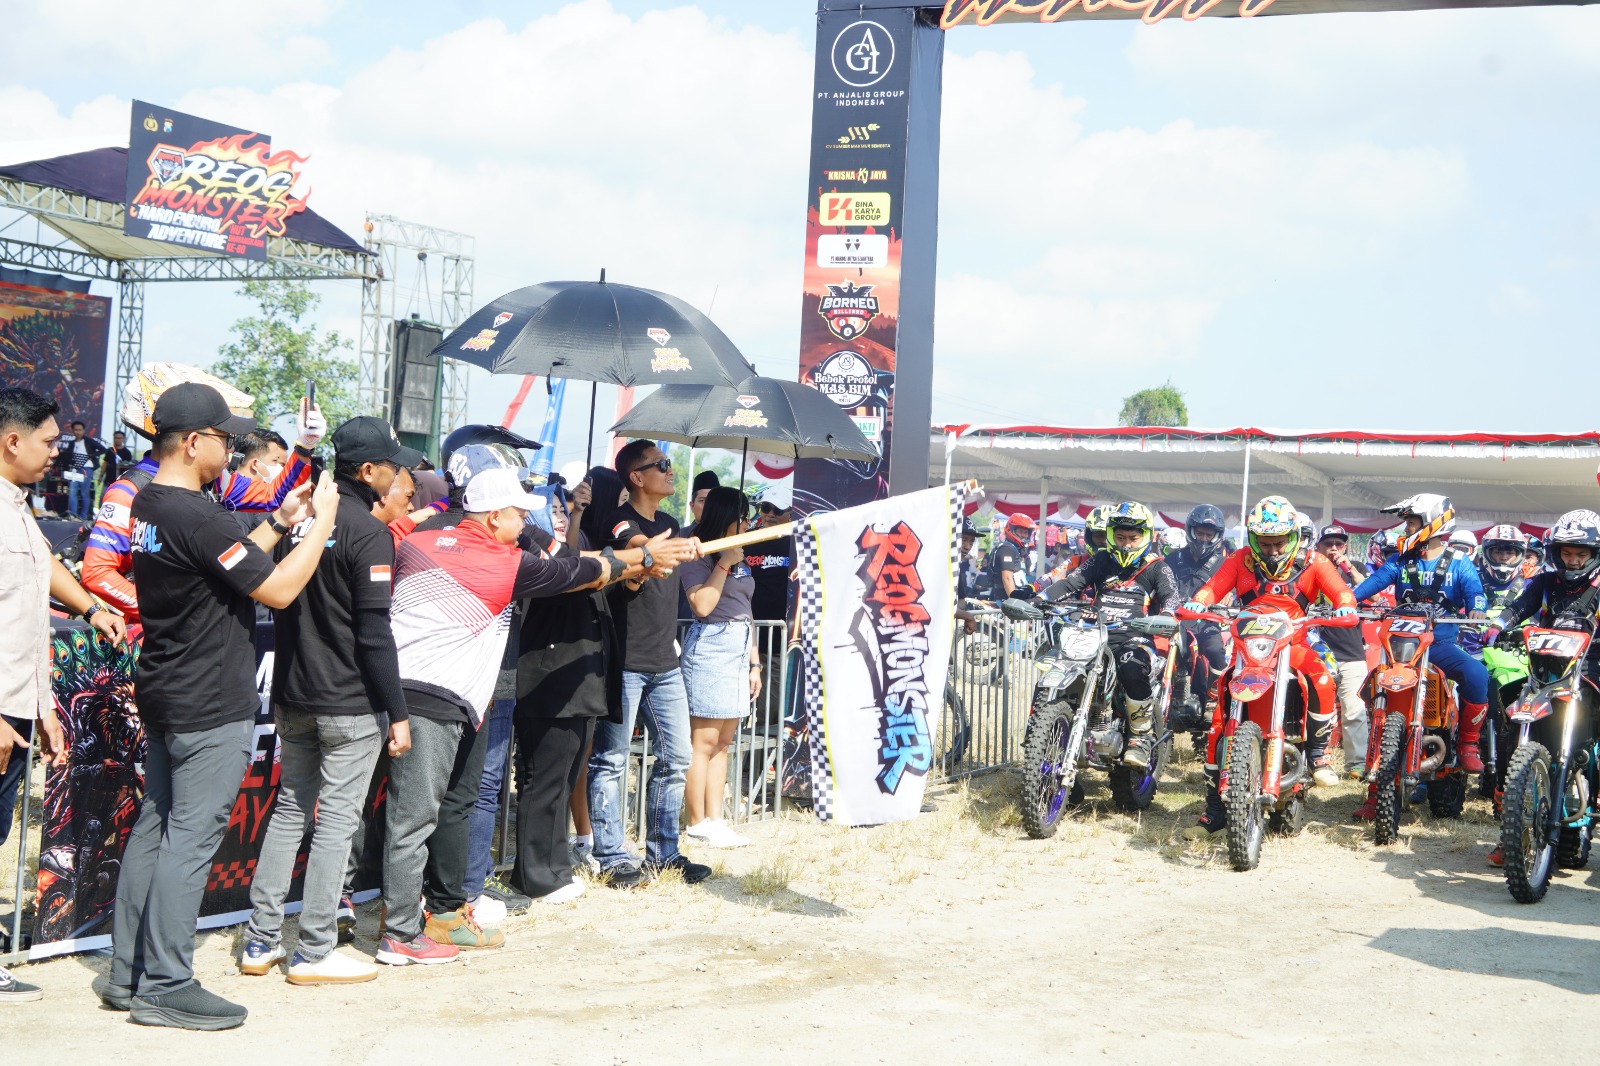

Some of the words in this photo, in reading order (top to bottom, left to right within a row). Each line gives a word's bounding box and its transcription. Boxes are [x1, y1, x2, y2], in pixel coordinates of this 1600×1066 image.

[833, 91, 871, 99] ANJALIS
[873, 90, 905, 98] GROUP
[835, 99, 885, 107] INDONESIA
[182, 153, 293, 203] REOG
[828, 170, 855, 180] KRISNA
[870, 170, 887, 180] JAYA
[137, 179, 284, 232] MONSTER
[137, 204, 175, 223] HARD
[172, 210, 221, 233] ENDURO
[147, 223, 228, 251] ADVENTURE
[823, 297, 876, 310] BORNEO
[815, 372, 845, 384] Bebek
[847, 373, 878, 385] Protol
[819, 384, 847, 395] MAS
[849, 384, 872, 396] BIM
[1240, 619, 1284, 636] 151
[1388, 619, 1427, 635] 272
